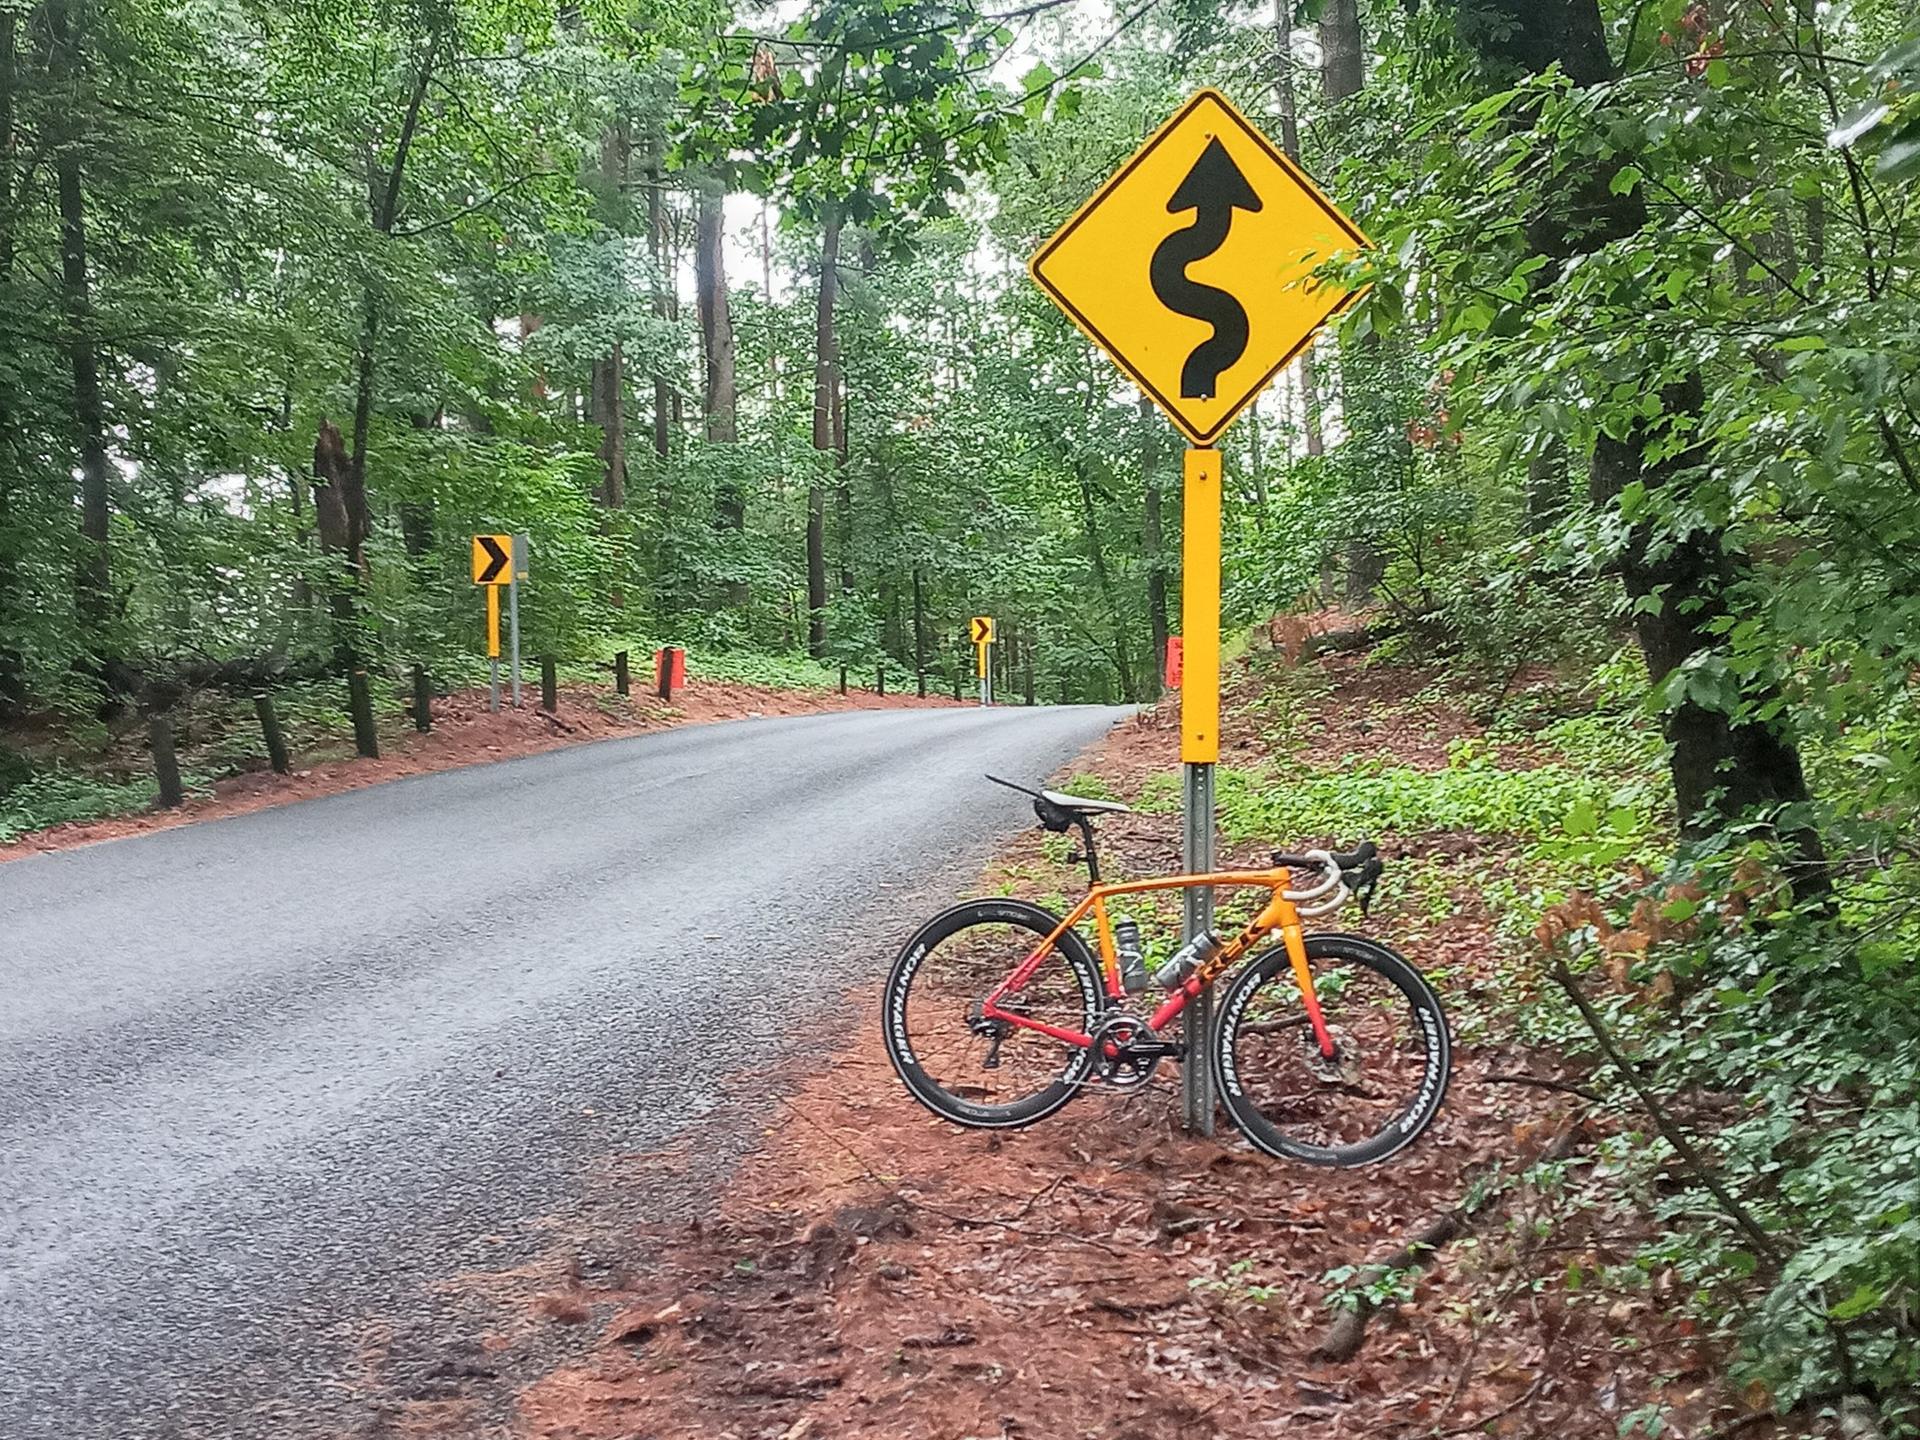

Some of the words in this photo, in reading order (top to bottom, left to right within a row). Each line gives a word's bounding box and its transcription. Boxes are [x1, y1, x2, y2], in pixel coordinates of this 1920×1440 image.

[893, 943, 926, 1065] BONTRAGER
[1222, 972, 1261, 1096] BONTRAGER
[1400, 1006, 1439, 1133] BONTRAGER
